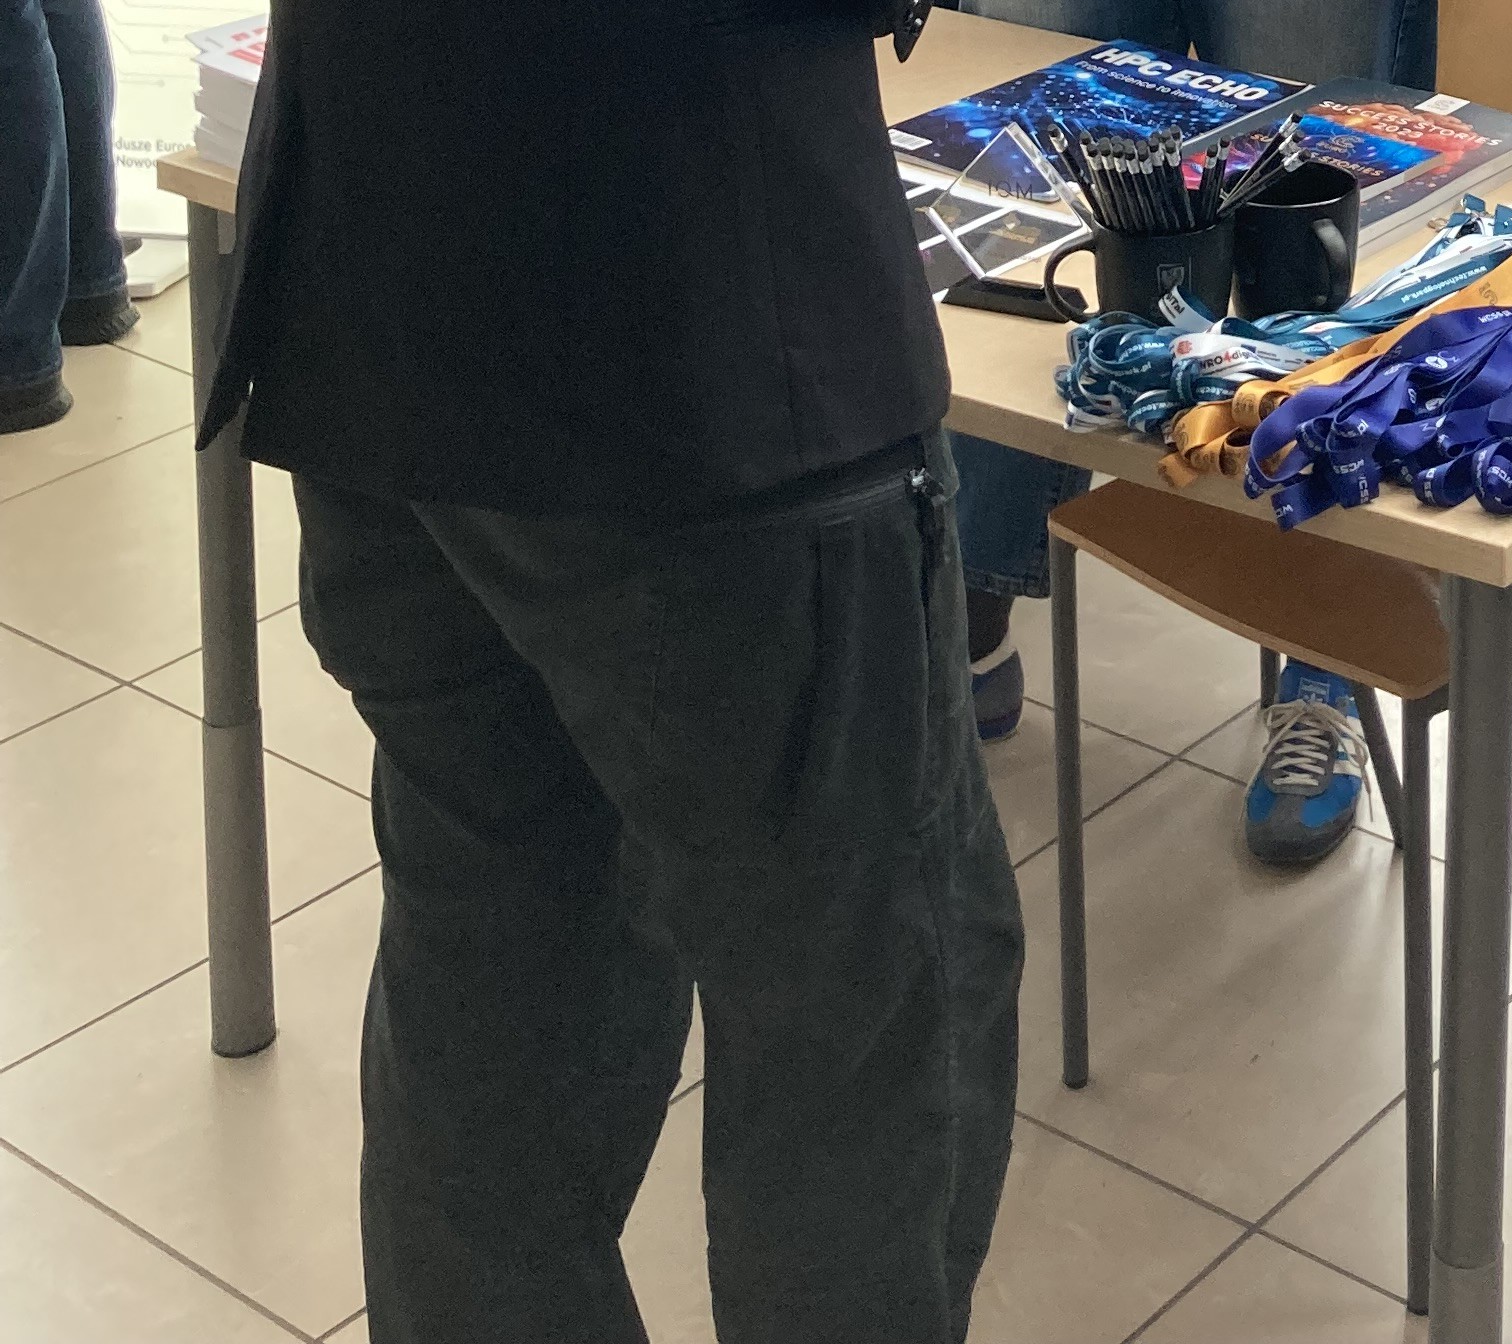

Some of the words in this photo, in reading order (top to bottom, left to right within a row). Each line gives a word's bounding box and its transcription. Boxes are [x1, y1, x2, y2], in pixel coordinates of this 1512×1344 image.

[1091, 48, 1173, 76] HPC
[1164, 69, 1269, 100] ECHO
[1107, 71, 1157, 90] science
[1318, 100, 1410, 126] SUCCESS
[1414, 120, 1503, 147] STORIES
